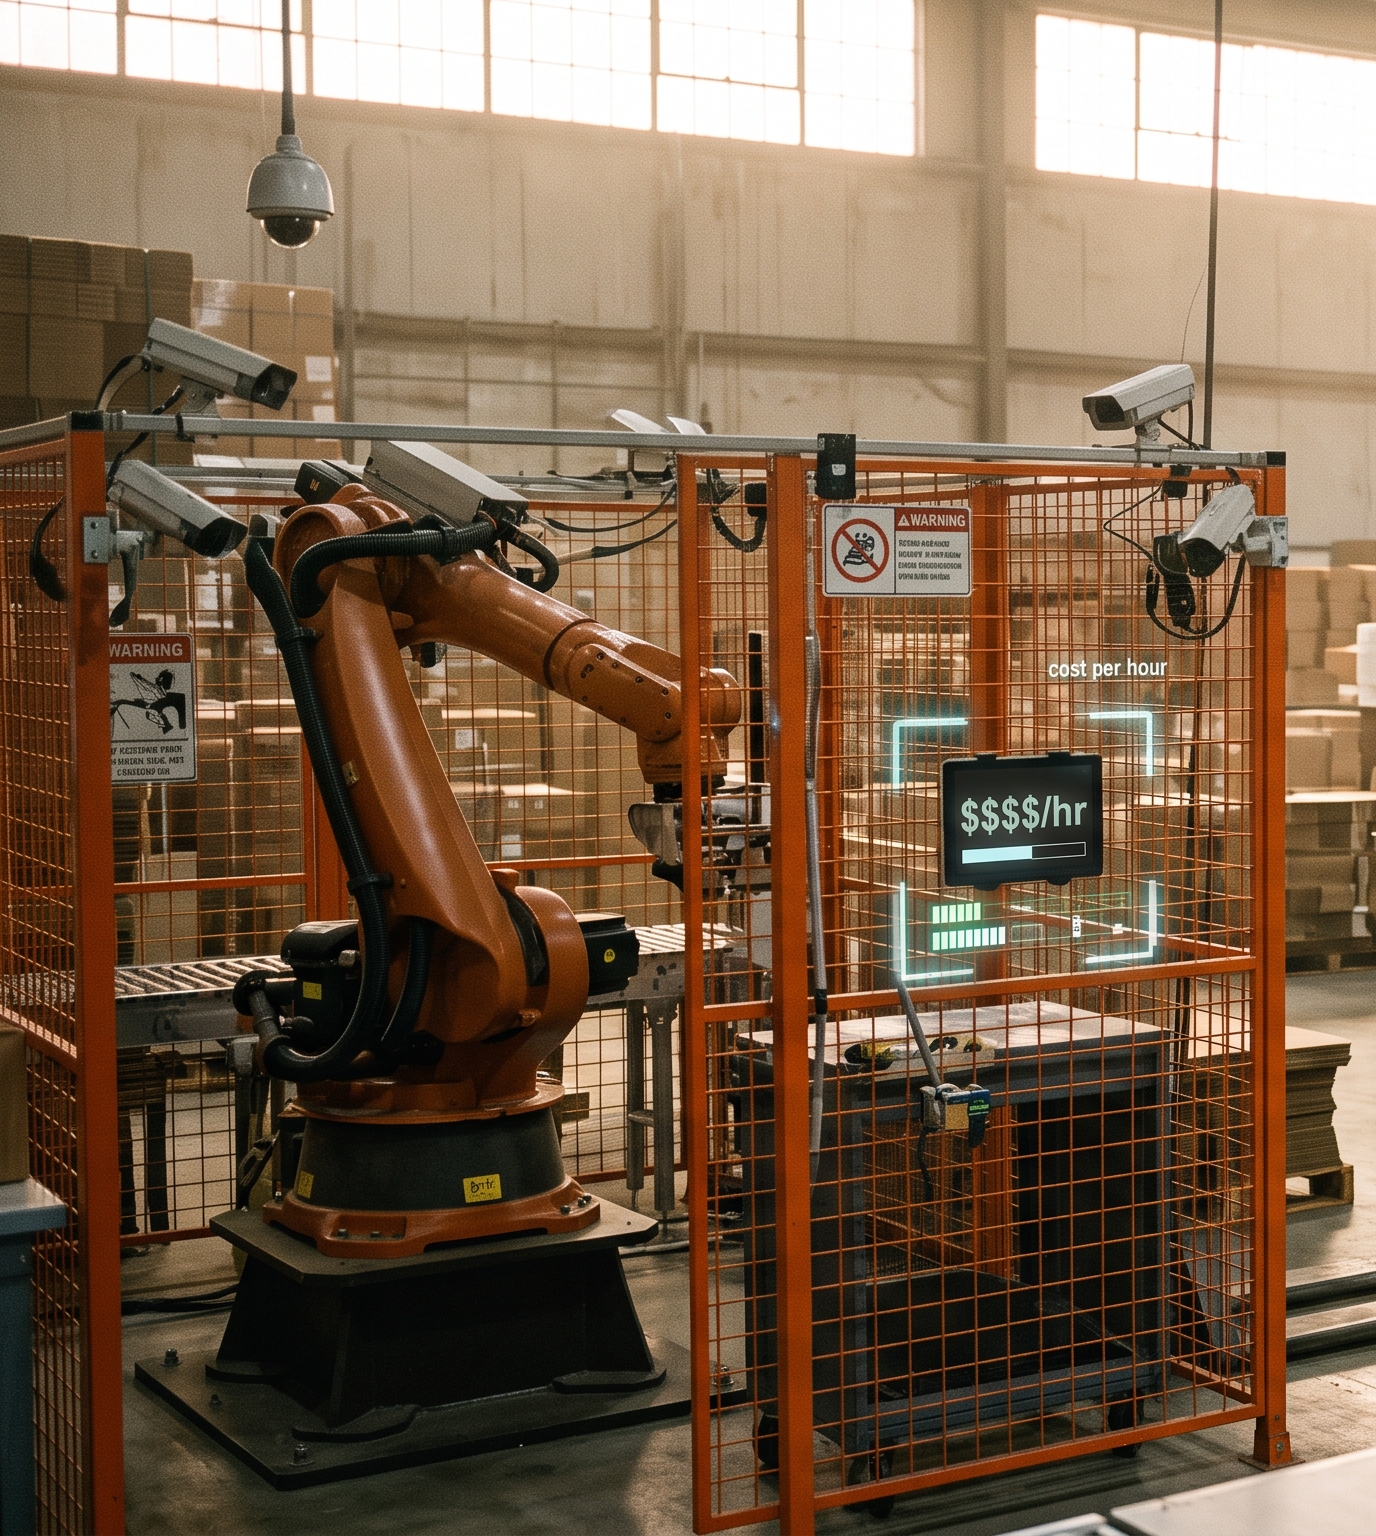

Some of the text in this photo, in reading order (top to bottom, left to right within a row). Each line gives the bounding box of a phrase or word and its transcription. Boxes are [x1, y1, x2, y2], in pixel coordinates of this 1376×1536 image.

[910, 514, 966, 527] WARNING
[109, 643, 183, 657] WARNING
[961, 794, 1087, 837] $$$$/hr
